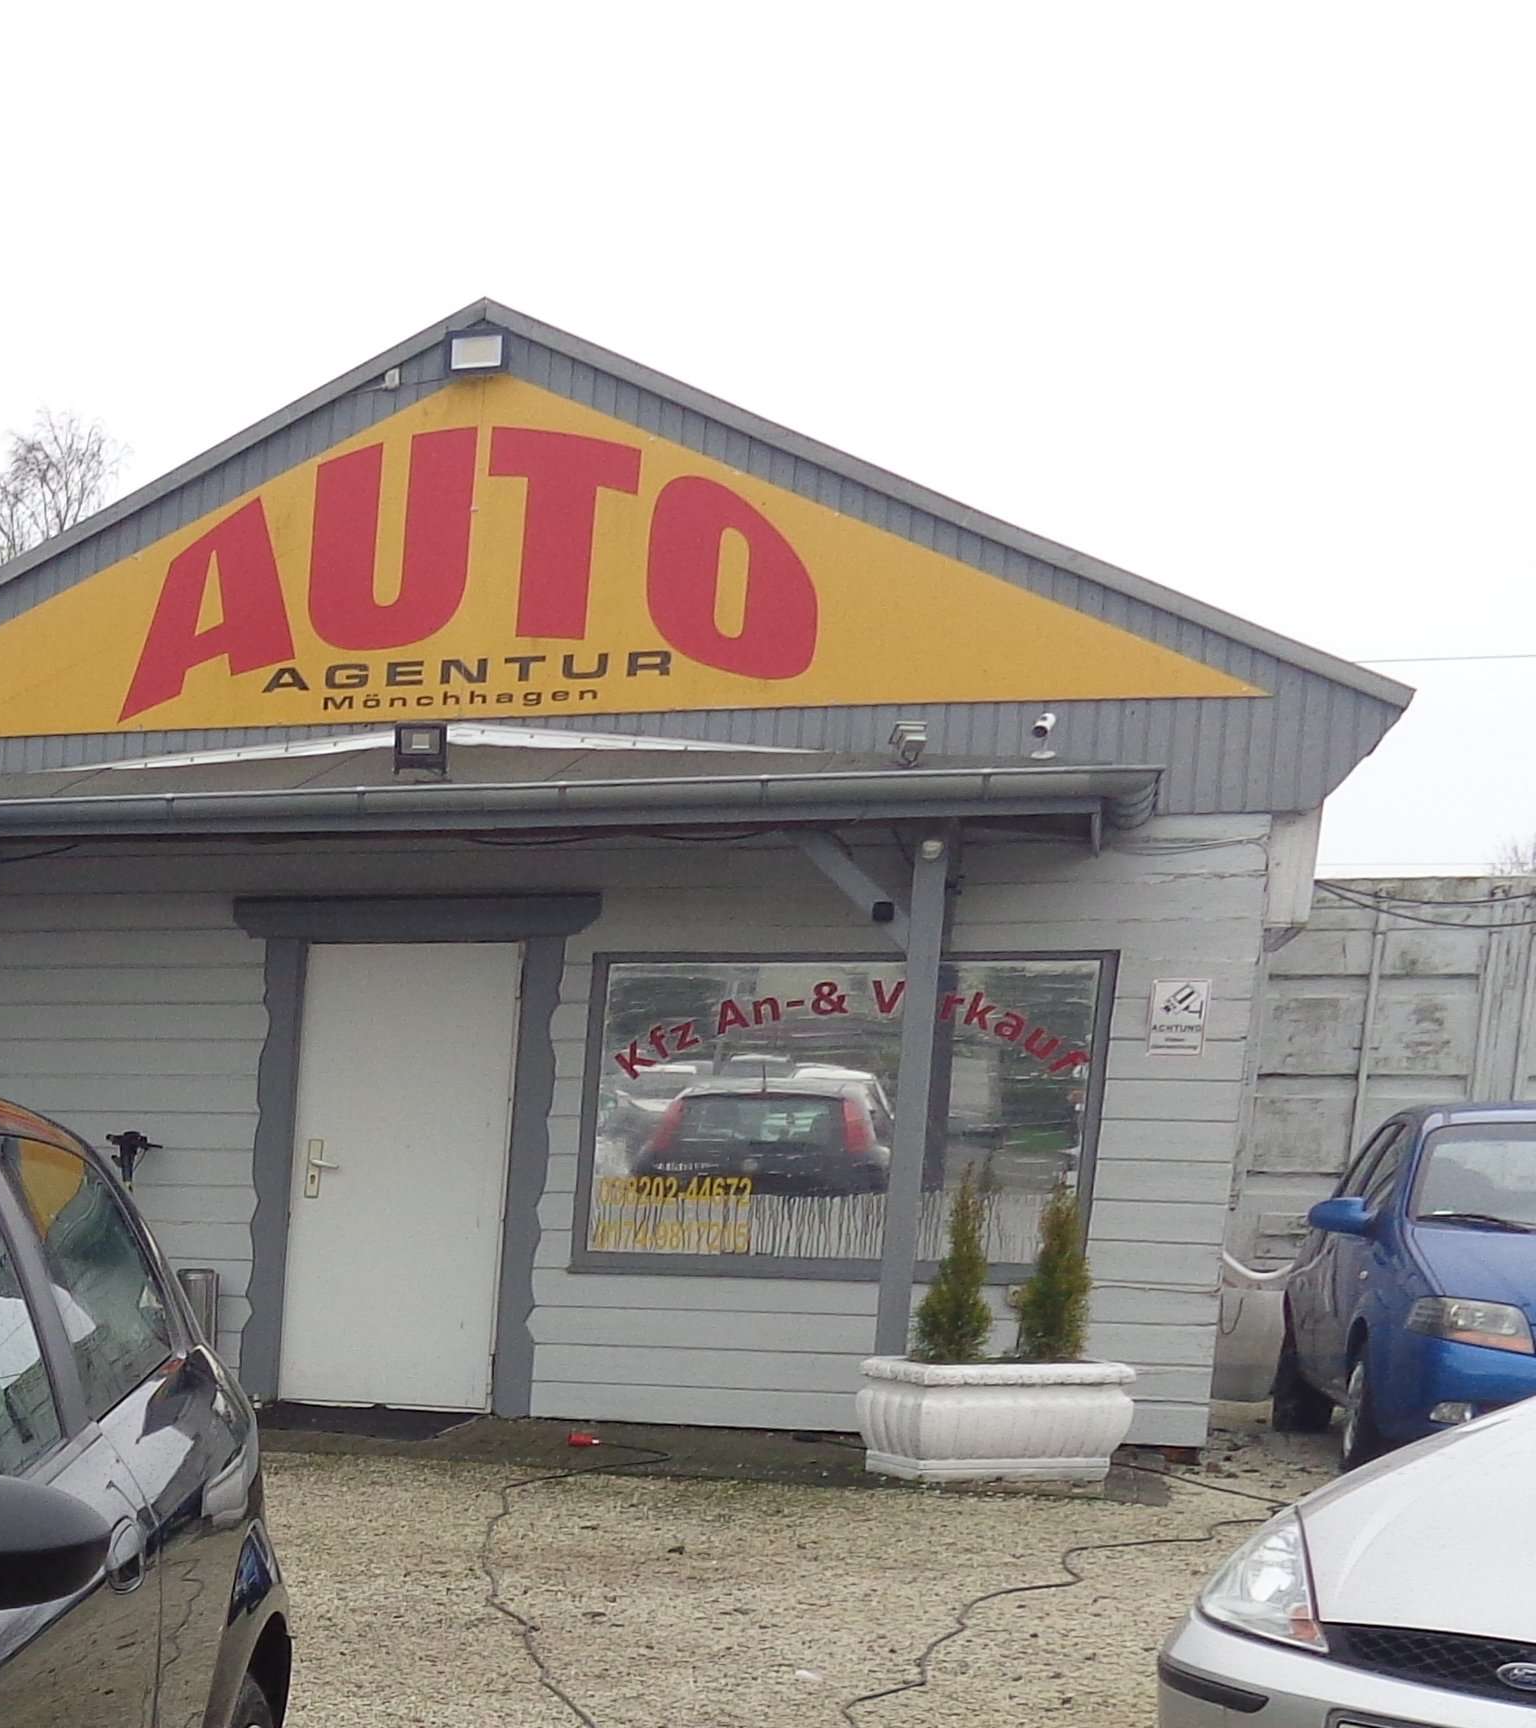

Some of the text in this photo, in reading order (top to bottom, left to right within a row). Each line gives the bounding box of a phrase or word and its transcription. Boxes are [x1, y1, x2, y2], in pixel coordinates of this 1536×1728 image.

[118, 426, 818, 724] AUTO
[262, 650, 672, 694] AGENTUR
[323, 687, 599, 711] Mönchhagen
[615, 1019, 703, 1080] Kfz
